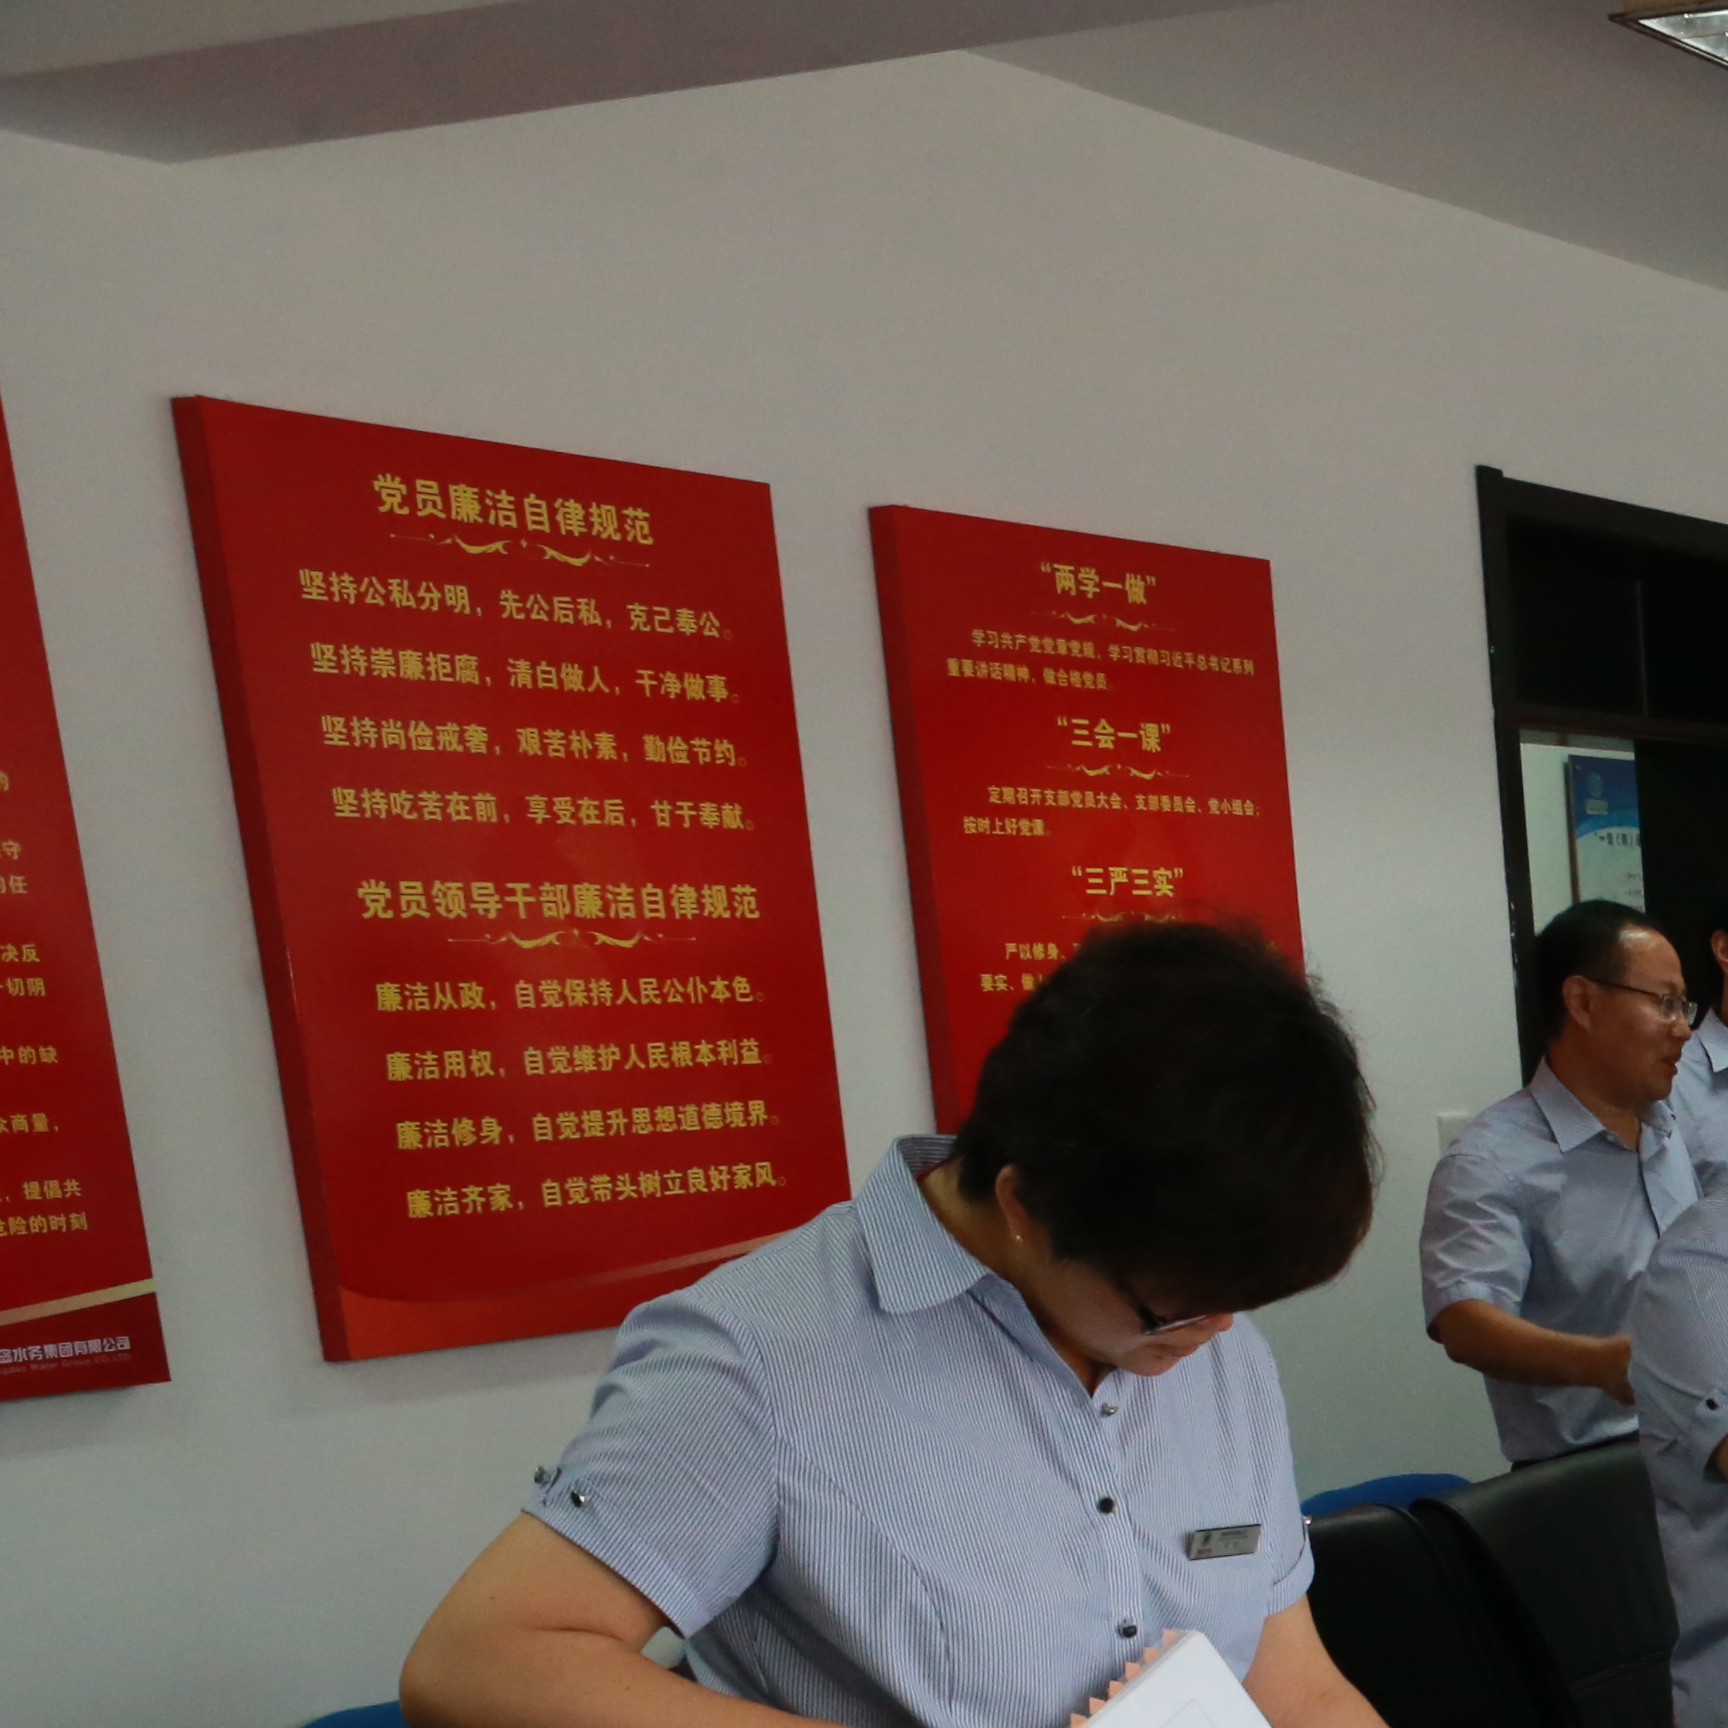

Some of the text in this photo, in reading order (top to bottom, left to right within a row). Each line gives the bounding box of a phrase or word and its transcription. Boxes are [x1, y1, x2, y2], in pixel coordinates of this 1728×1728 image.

[373, 475, 654, 545] 党员廉洁自律规范
[299, 569, 732, 640] 坚持公私分明，先公后私，克己奉公。
[1041, 563, 1156, 604] “两学一做”
[310, 643, 740, 702] 坚持崇廉拒腐，清白做人，干净做事。
[321, 716, 747, 767] 坚持尚俭戒奢，艰苦朴素，勤俭节约。
[1058, 717, 1170, 751] “三会一课”
[332, 788, 754, 831] 坚持吃苦在前，享受在后，甘于奉献。
[358, 881, 760, 920] 党员领导干部廉洁自律规范
[1072, 867, 1183, 896] “三严三实”
[1006, 943, 1077, 960] 严以修身、
[376, 976, 764, 1011] 廉洁从政，自觉保持人民公仆本色。
[386, 1039, 772, 1081] 廉洁用权，自觉维护人民根本利益。
[396, 1100, 779, 1150] 廉洁修身，自觉提升思想道德境界。
[407, 1162, 786, 1218] 廉洁齐家，自觉带头树立良好家风。
